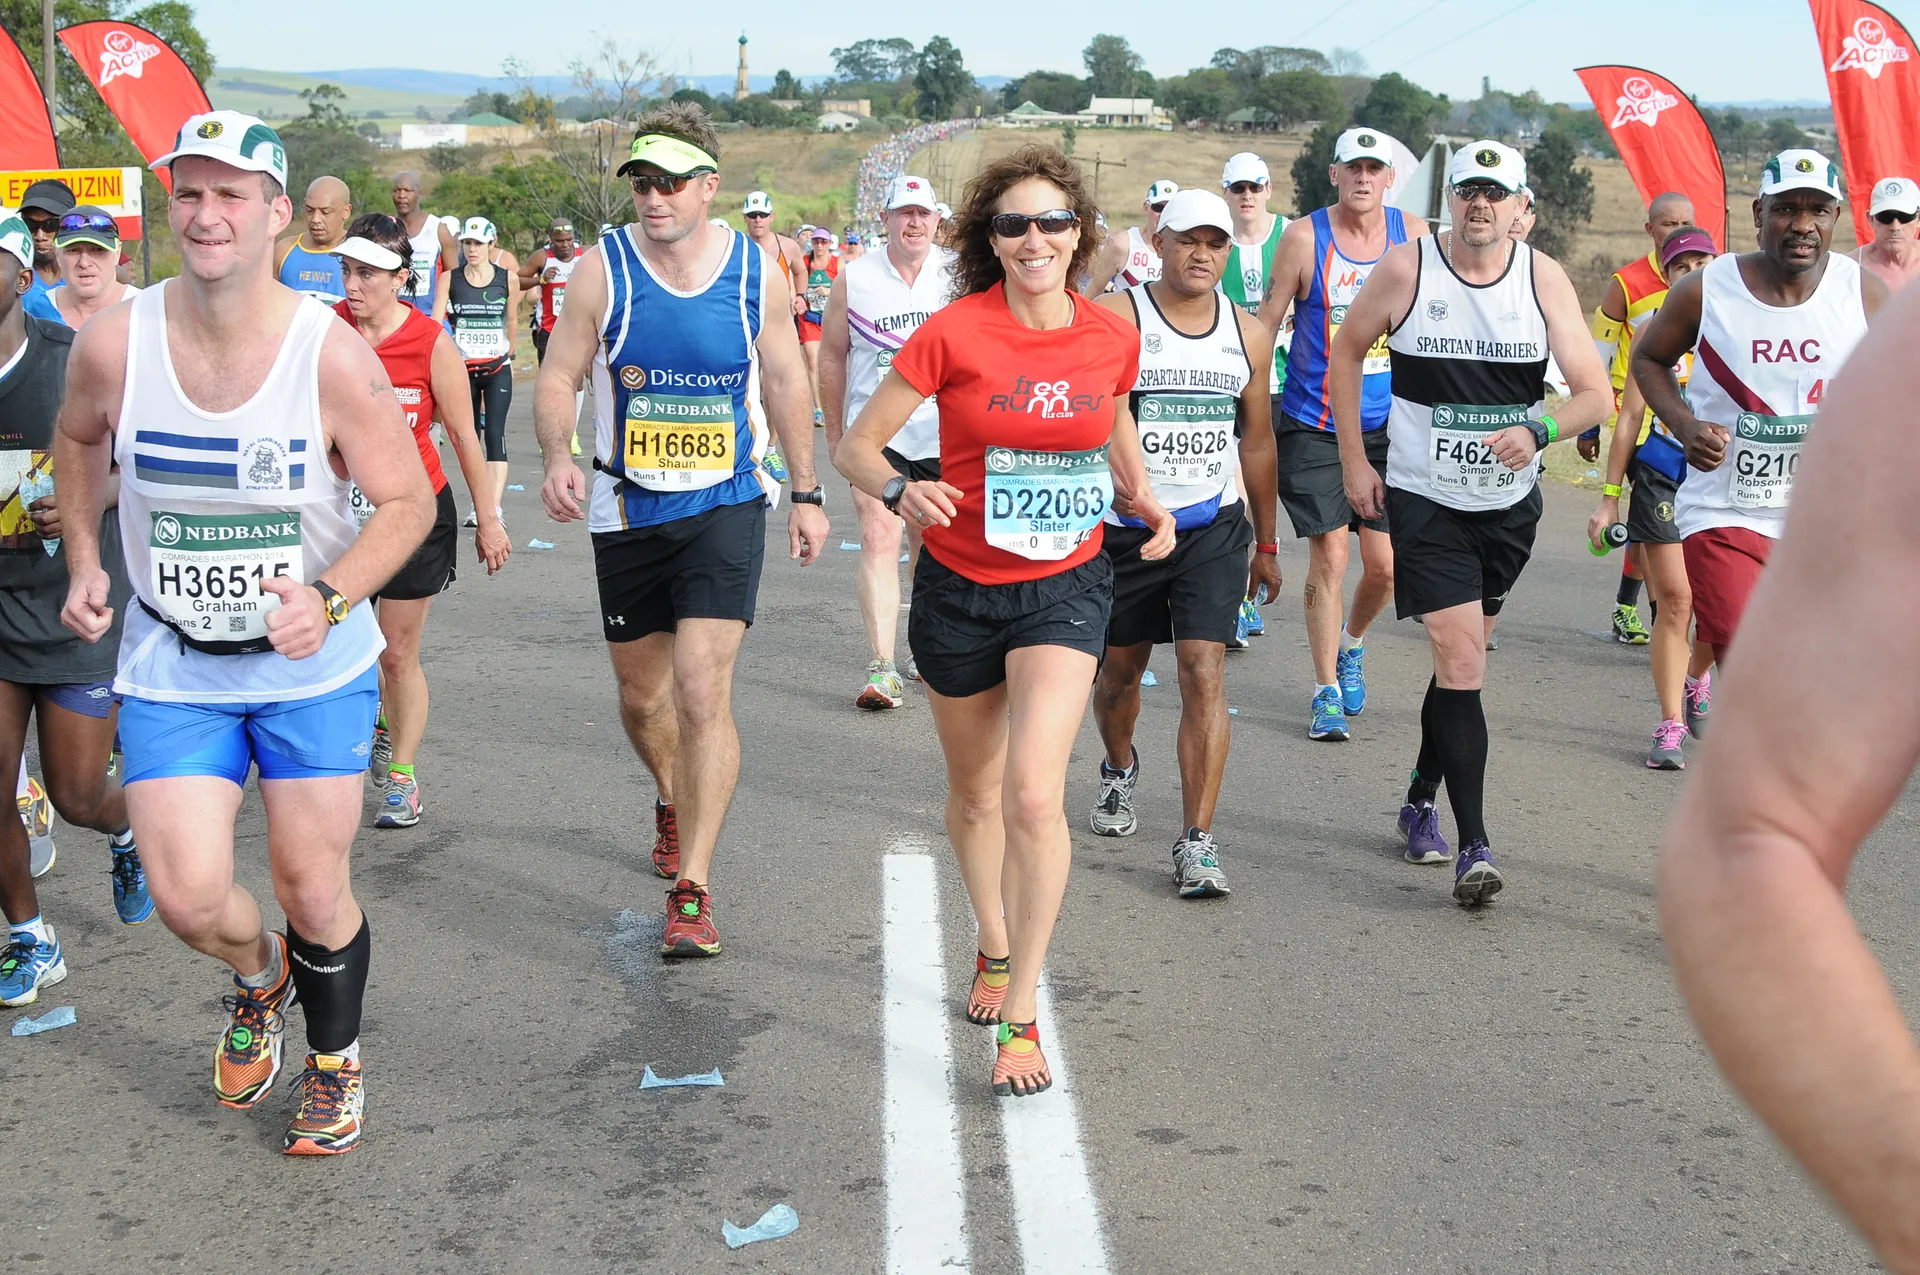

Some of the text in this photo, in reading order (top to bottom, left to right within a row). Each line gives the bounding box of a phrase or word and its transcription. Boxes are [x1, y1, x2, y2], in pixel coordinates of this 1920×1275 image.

[105, 43, 159, 77] ACTIVE
[1839, 46, 1905, 66] ACTIVE
[8, 175, 121, 200] EZUZINI
[1133, 251, 1148, 267] 60
[299, 270, 333, 283] HEWAT
[1147, 267, 1162, 278] RA
[1338, 270, 1363, 287] Ma
[459, 333, 498, 345] F39999
[1416, 336, 1538, 358] SPARTAN HARRIERS
[1752, 338, 1821, 363] RAC
[1375, 350, 1389, 358] Joh
[650, 369, 744, 387] Discovery
[1140, 369, 1241, 392] SPARTAN HARRIERS
[393, 387, 421, 397] ROSPEC
[1806, 378, 1824, 409] 4
[654, 402, 731, 416] NEDBANK
[1165, 404, 1234, 415] NEDBANK
[1457, 412, 1527, 424] NEDBANK
[634, 422, 670, 431] COMRADES
[1762, 423, 1809, 436] NEDB
[1438, 431, 1472, 439] COMRADES
[629, 430, 726, 458] H16683
[1142, 430, 1227, 455] G49626
[1742, 441, 1778, 451] COMRADES
[1435, 438, 1500, 465] F462
[658, 458, 696, 468] Shaun
[1020, 451, 1106, 468] NEDBANK
[1163, 456, 1208, 466] Anthony
[1736, 450, 1801, 477] G210
[633, 471, 666, 481] Runs 1
[1145, 467, 1177, 476] Runs 3
[1206, 462, 1222, 478] 50
[1459, 465, 1494, 474] Simon
[996, 478, 1042, 486] COMRADES
[1437, 474, 1468, 486] Runs 0
[1496, 472, 1515, 487] 50
[1737, 475, 1782, 487] Robson
[1737, 489, 1772, 499] Runs 0
[992, 486, 1104, 519] D22063
[185, 522, 297, 541] NEDBANK
[1029, 520, 1072, 532] Slater
[1029, 535, 1038, 548] 0
[162, 552, 284, 563] COMRADES MARATHON 2014
[192, 600, 257, 613] Graham
[202, 616, 212, 629] 2
